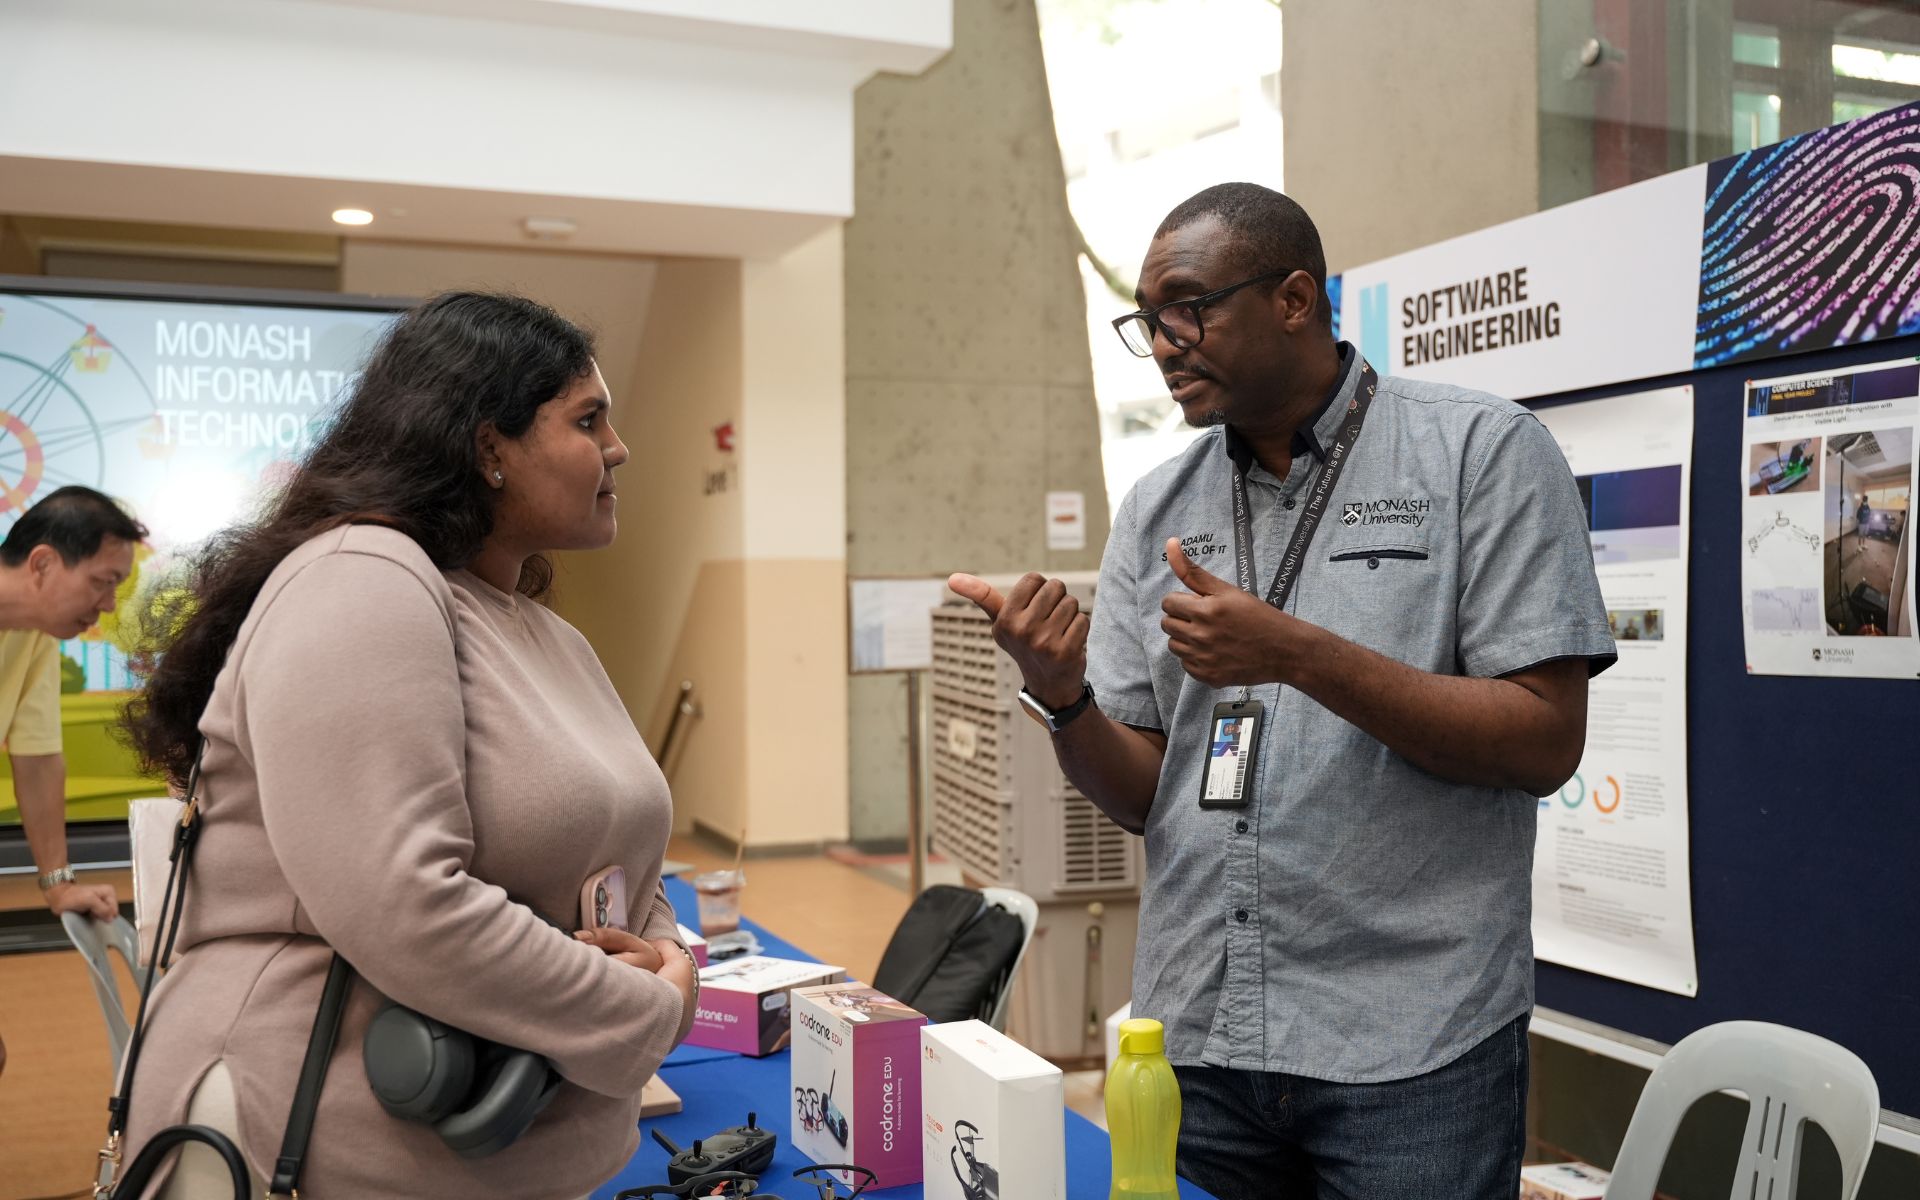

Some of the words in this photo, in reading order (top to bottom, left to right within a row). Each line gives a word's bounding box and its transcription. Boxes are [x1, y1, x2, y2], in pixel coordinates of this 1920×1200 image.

[1402, 266, 1528, 329] SOFTWARE
[155, 319, 312, 362] MONASH
[1403, 302, 1561, 368] ENGINEERING
[156, 364, 346, 405] INFORMATI
[1771, 382, 1805, 394] COMPUTER
[1807, 377, 1833, 388] SCIENCE
[1795, 389, 1815, 397] PROJECT
[157, 408, 311, 449] TECHNOL
[1332, 442, 1345, 459] @IT
[1330, 460, 1338, 469] is
[1317, 466, 1335, 496] Future
[1236, 491, 1244, 516] School
[1309, 495, 1323, 510] The
[1364, 499, 1430, 514] MONASH
[1362, 512, 1425, 528] University
[1181, 533, 1213, 547] ADAMU
[1238, 522, 1247, 556] University
[1292, 517, 1314, 556] University
[1201, 545, 1215, 555] OF
[1218, 544, 1227, 554] IT
[1240, 555, 1251, 592] MONASH
[1274, 553, 1298, 595] MONASH
[1823, 647, 1854, 657] MONASH
[1824, 655, 1853, 664] University
[695, 1006, 723, 1022] drone
[723, 1013, 738, 1024] EDU
[800, 1011, 831, 1040] codrone
[831, 1032, 843, 1047] EDU
[884, 1056, 892, 1079] EDU
[880, 1082, 893, 1152] codrone
